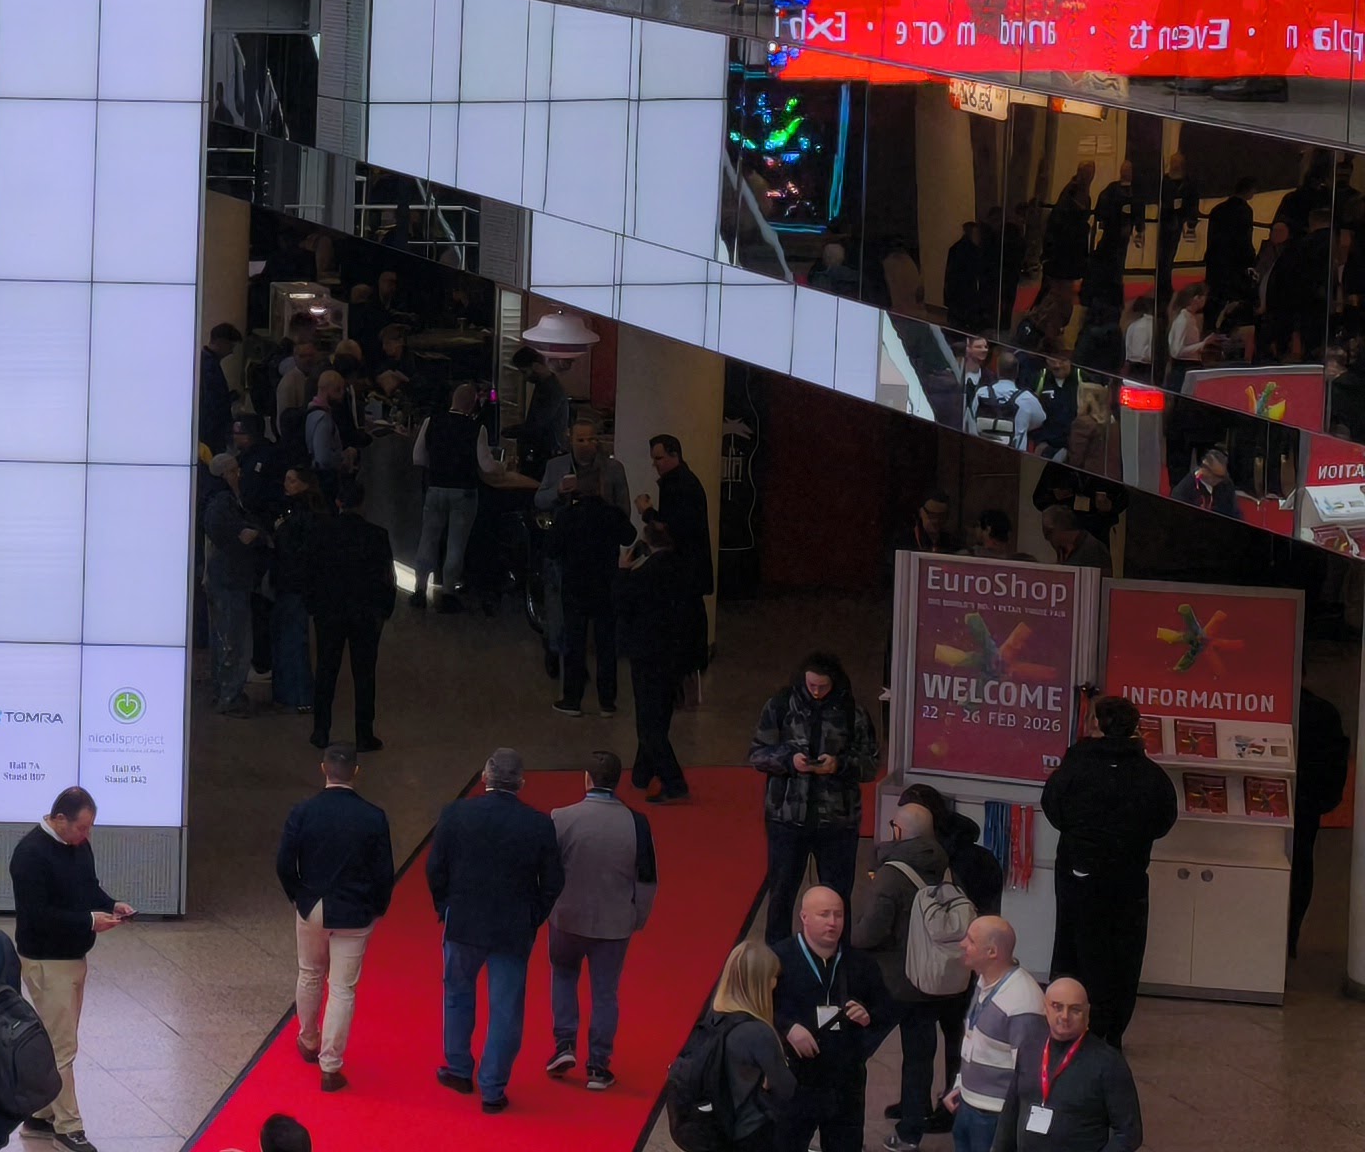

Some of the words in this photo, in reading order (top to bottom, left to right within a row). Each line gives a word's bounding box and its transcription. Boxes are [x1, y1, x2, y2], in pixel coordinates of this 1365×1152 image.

[927, 565, 1067, 608] EuroShop
[922, 672, 1063, 712] WELCOME
[1122, 685, 1274, 713] INFORMATION
[4, 711, 64, 724] TOMRA
[922, 705, 938, 719] 22
[962, 708, 981, 724] 26
[988, 711, 1016, 727] FEB
[1023, 716, 1061, 732] 2026
[88, 732, 165, 747] nicolisproject
[9, 761, 27, 770] Hall
[111, 765, 129, 773] Hall
[3, 772, 27, 781] Stand
[104, 775, 129, 784] Stand
